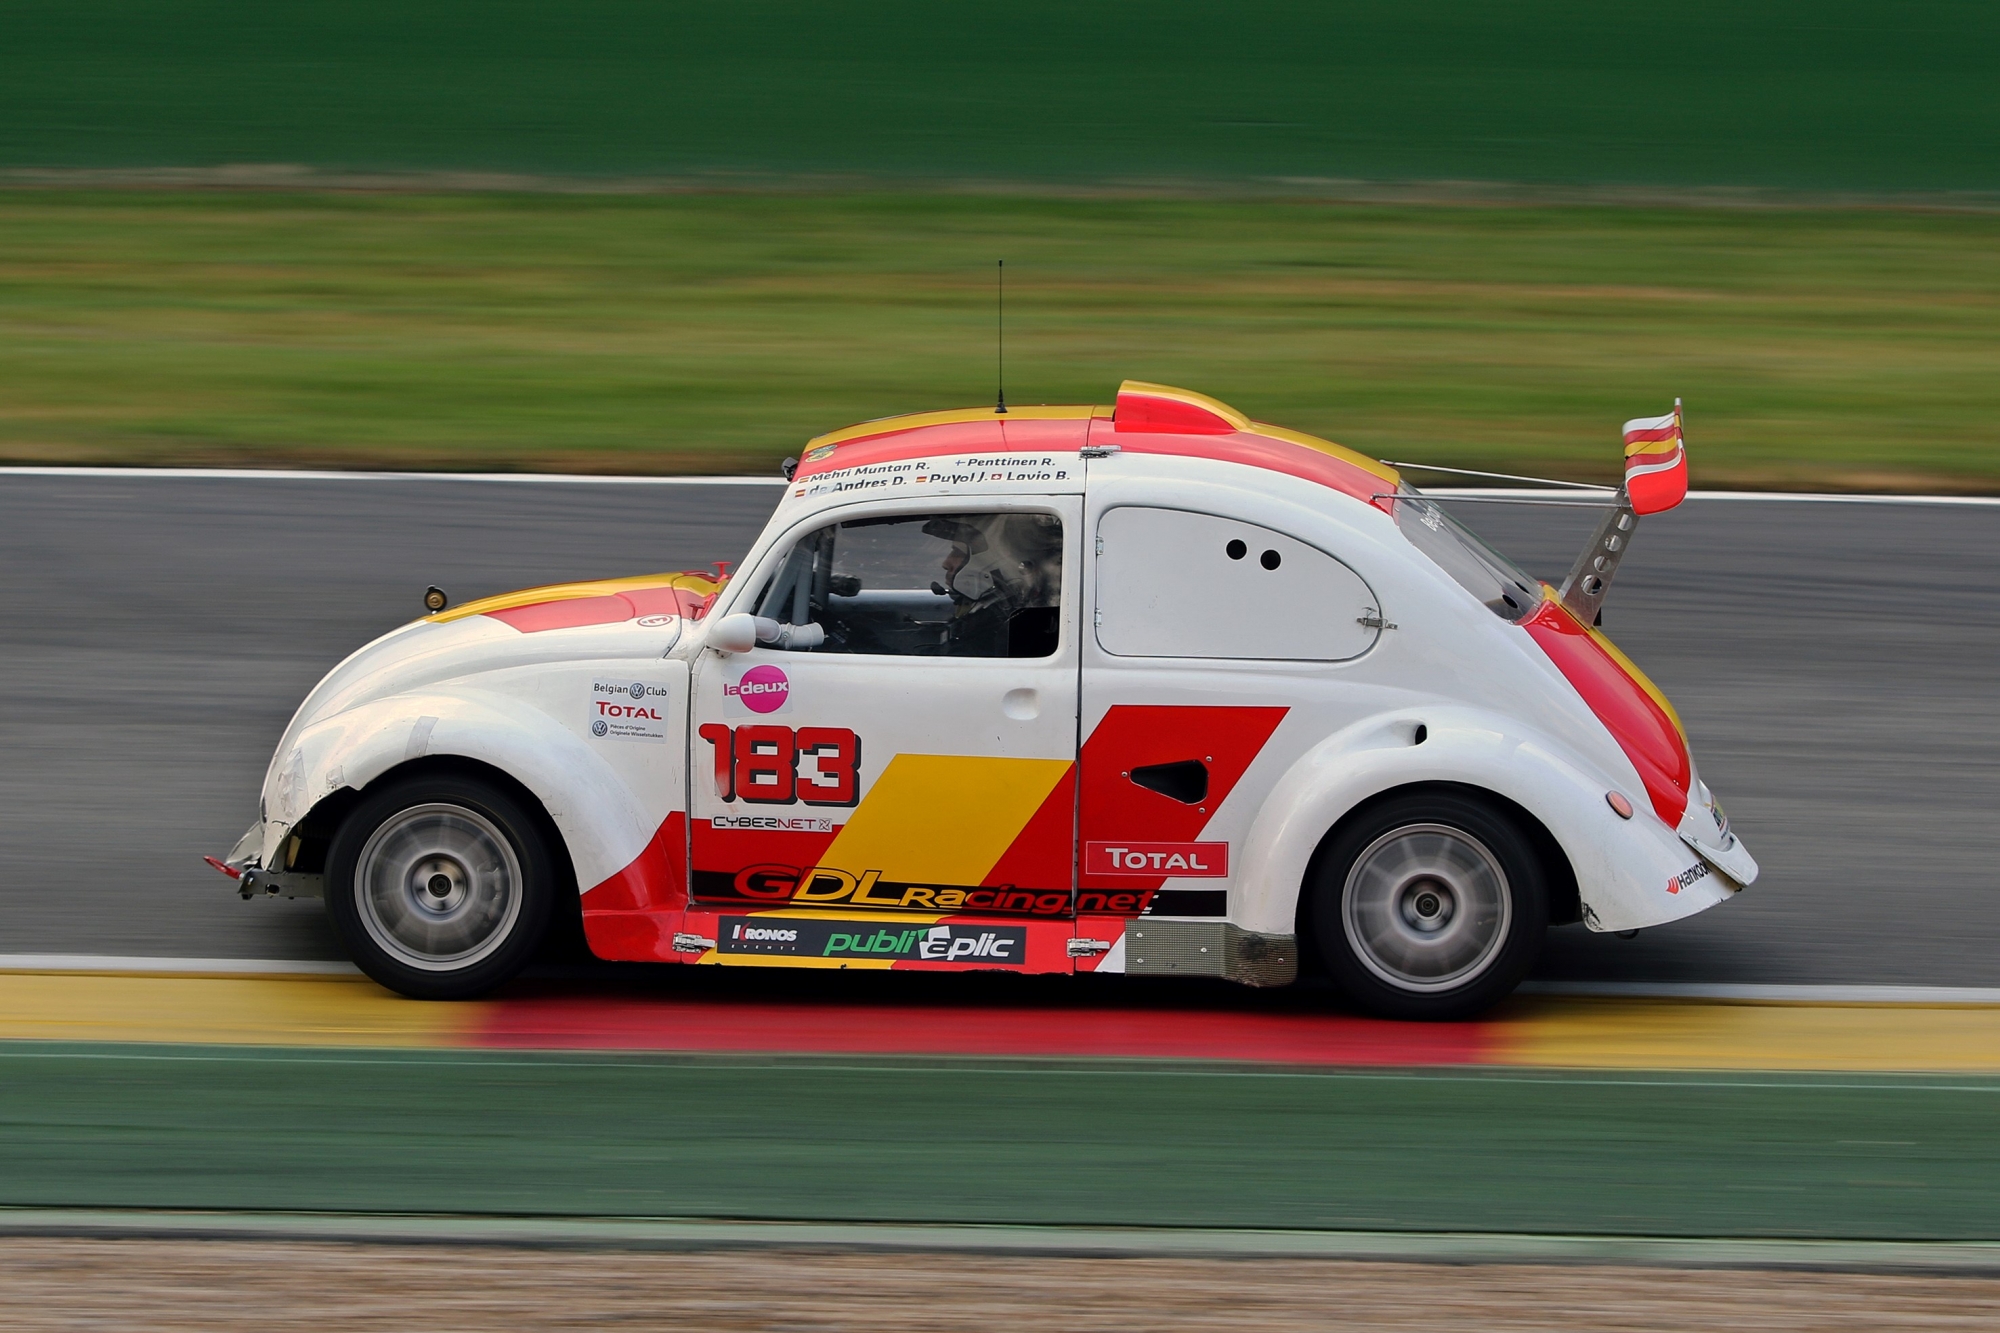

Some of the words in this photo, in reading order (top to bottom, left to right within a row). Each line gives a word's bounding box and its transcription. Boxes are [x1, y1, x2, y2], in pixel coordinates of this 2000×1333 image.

[810, 469, 852, 482] Mehri
[855, 463, 911, 476] Muntan
[915, 462, 930, 471] R.
[967, 458, 1037, 467] Penttinen
[1041, 458, 1056, 466] R.
[831, 479, 888, 493] Andres
[892, 476, 907, 486] D.
[977, 471, 988, 483] J.
[1006, 471, 1051, 481] Lavio
[1055, 471, 1070, 480] B.
[593, 683, 628, 694] Belgian
[646, 687, 667, 696] Club
[596, 701, 662, 720] TOTAL
[698, 723, 862, 808] 183
[713, 816, 816, 829] CYBERNET
[1105, 848, 1208, 870] TOTAL
